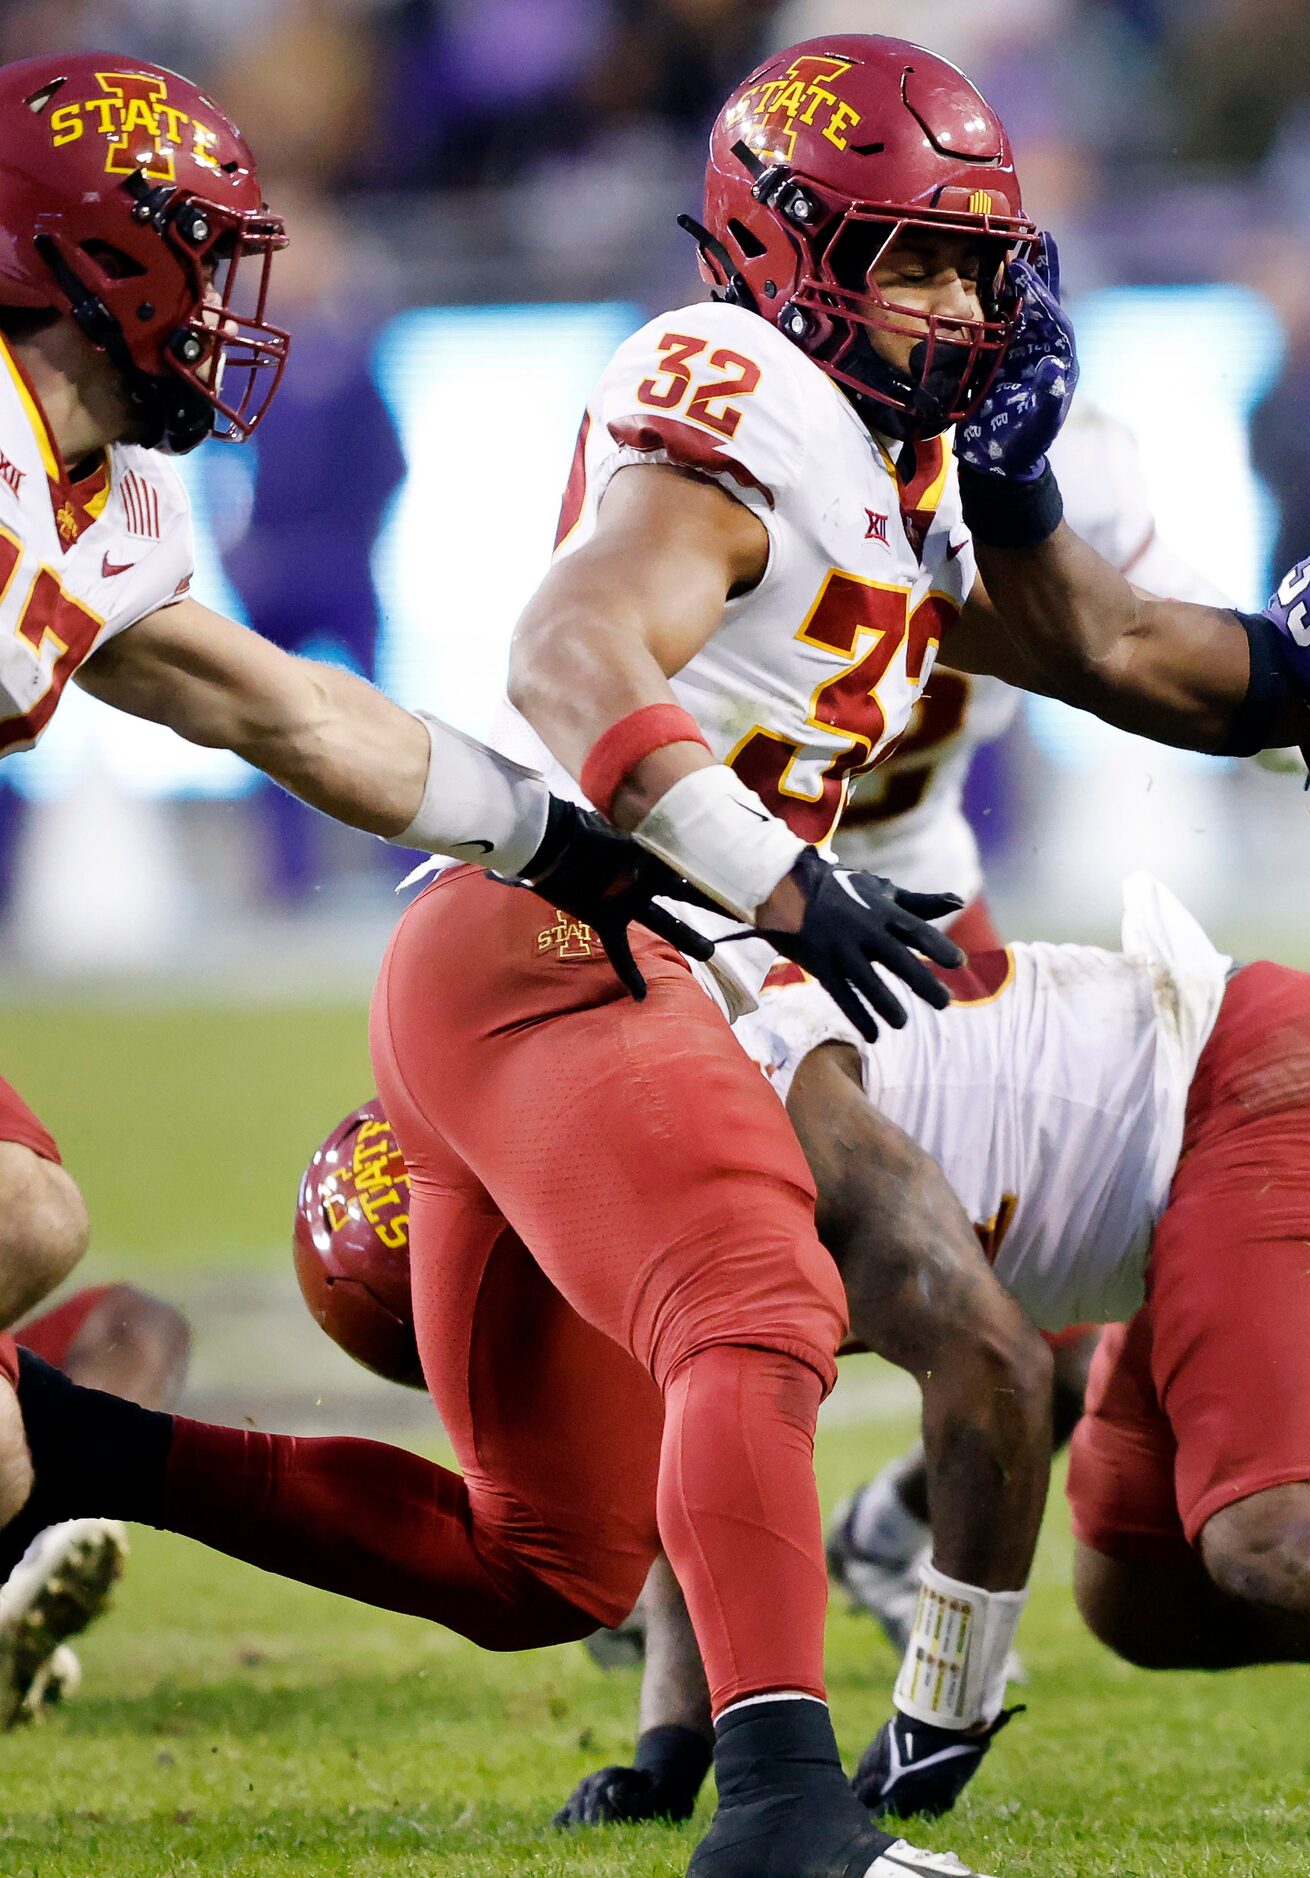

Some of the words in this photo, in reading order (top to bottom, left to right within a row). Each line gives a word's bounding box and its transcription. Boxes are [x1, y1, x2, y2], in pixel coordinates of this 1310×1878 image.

[725, 80, 862, 151] STATE
[51, 98, 219, 168] STATE
[635, 332, 762, 441] 32
[995, 382, 1022, 393] TCU
[963, 425, 982, 442] TCU
[990, 412, 1008, 432] TCU
[537, 923, 602, 950] STAT
